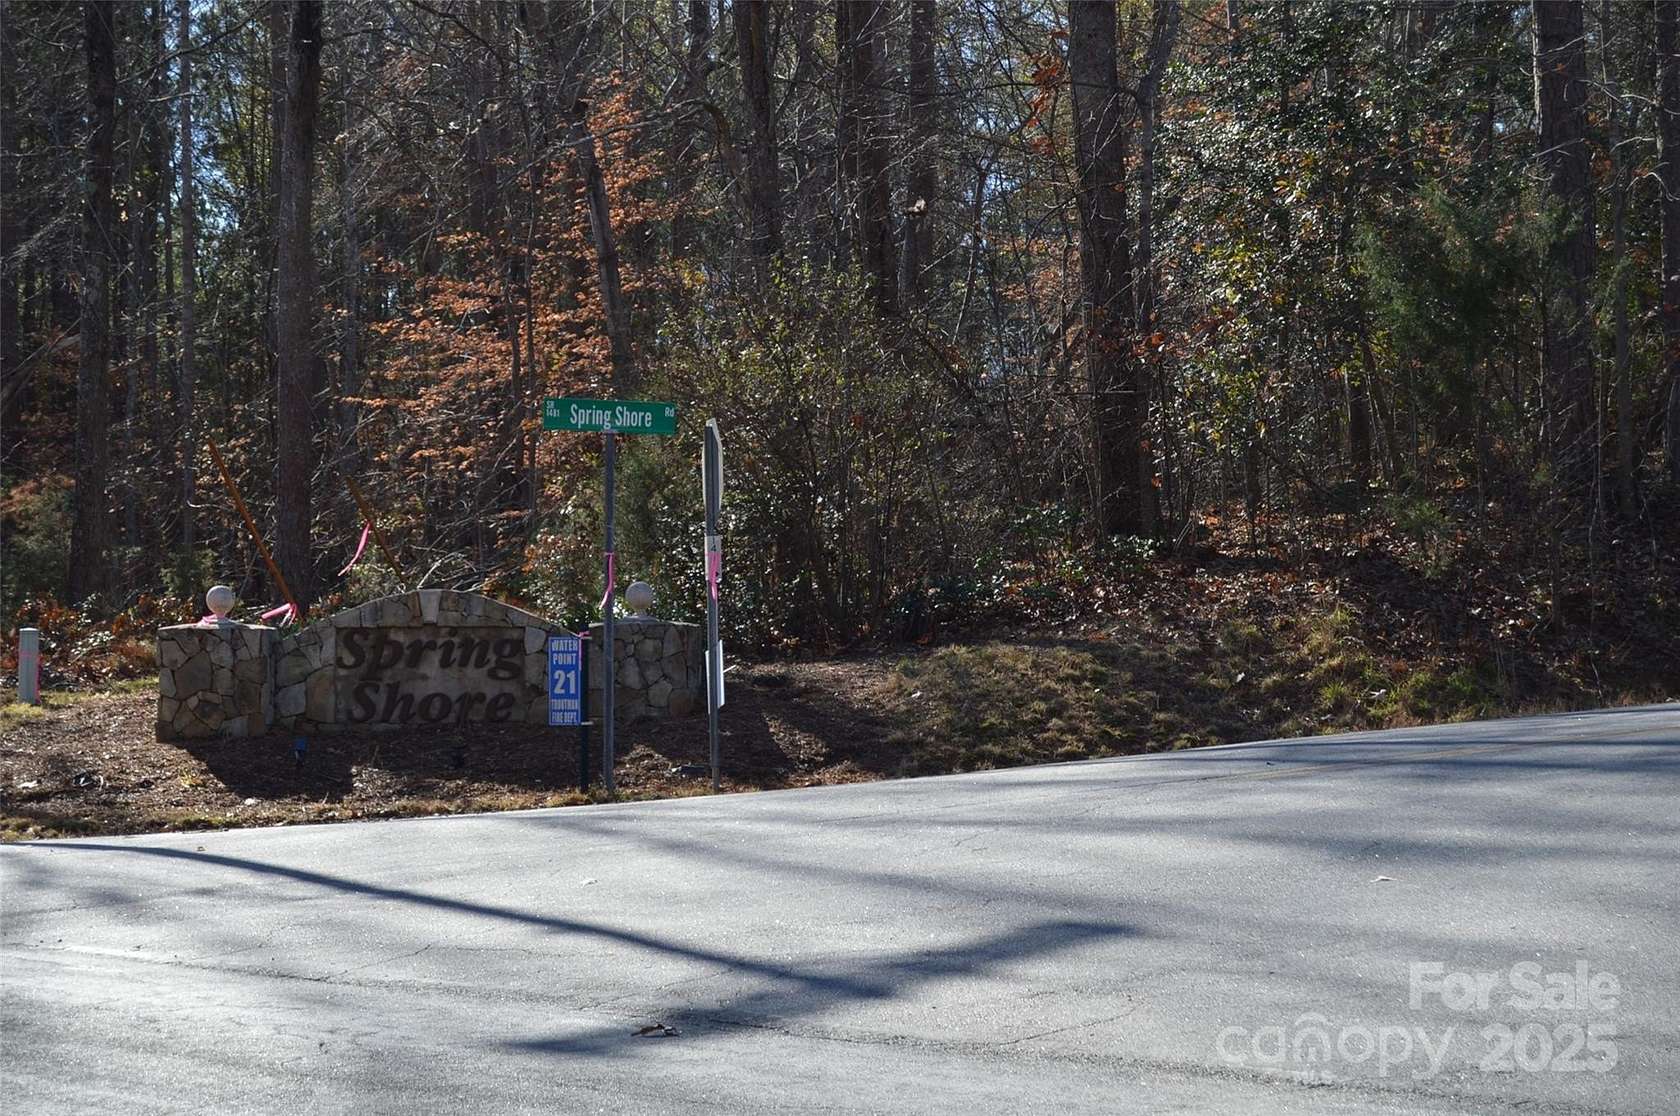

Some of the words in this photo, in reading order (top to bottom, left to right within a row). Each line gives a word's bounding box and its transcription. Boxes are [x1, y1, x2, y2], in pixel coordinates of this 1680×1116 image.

[546, 409, 560, 417] 1481
[570, 403, 612, 430] Spring
[615, 406, 652, 427] Shore
[664, 407, 675, 418] Rd
[336, 628, 523, 681] Spring
[551, 640, 578, 652] WATER
[552, 653, 577, 665] POINT
[553, 670, 576, 695] 21
[350, 681, 518, 723] Shore
[552, 711, 563, 724] FIRE
